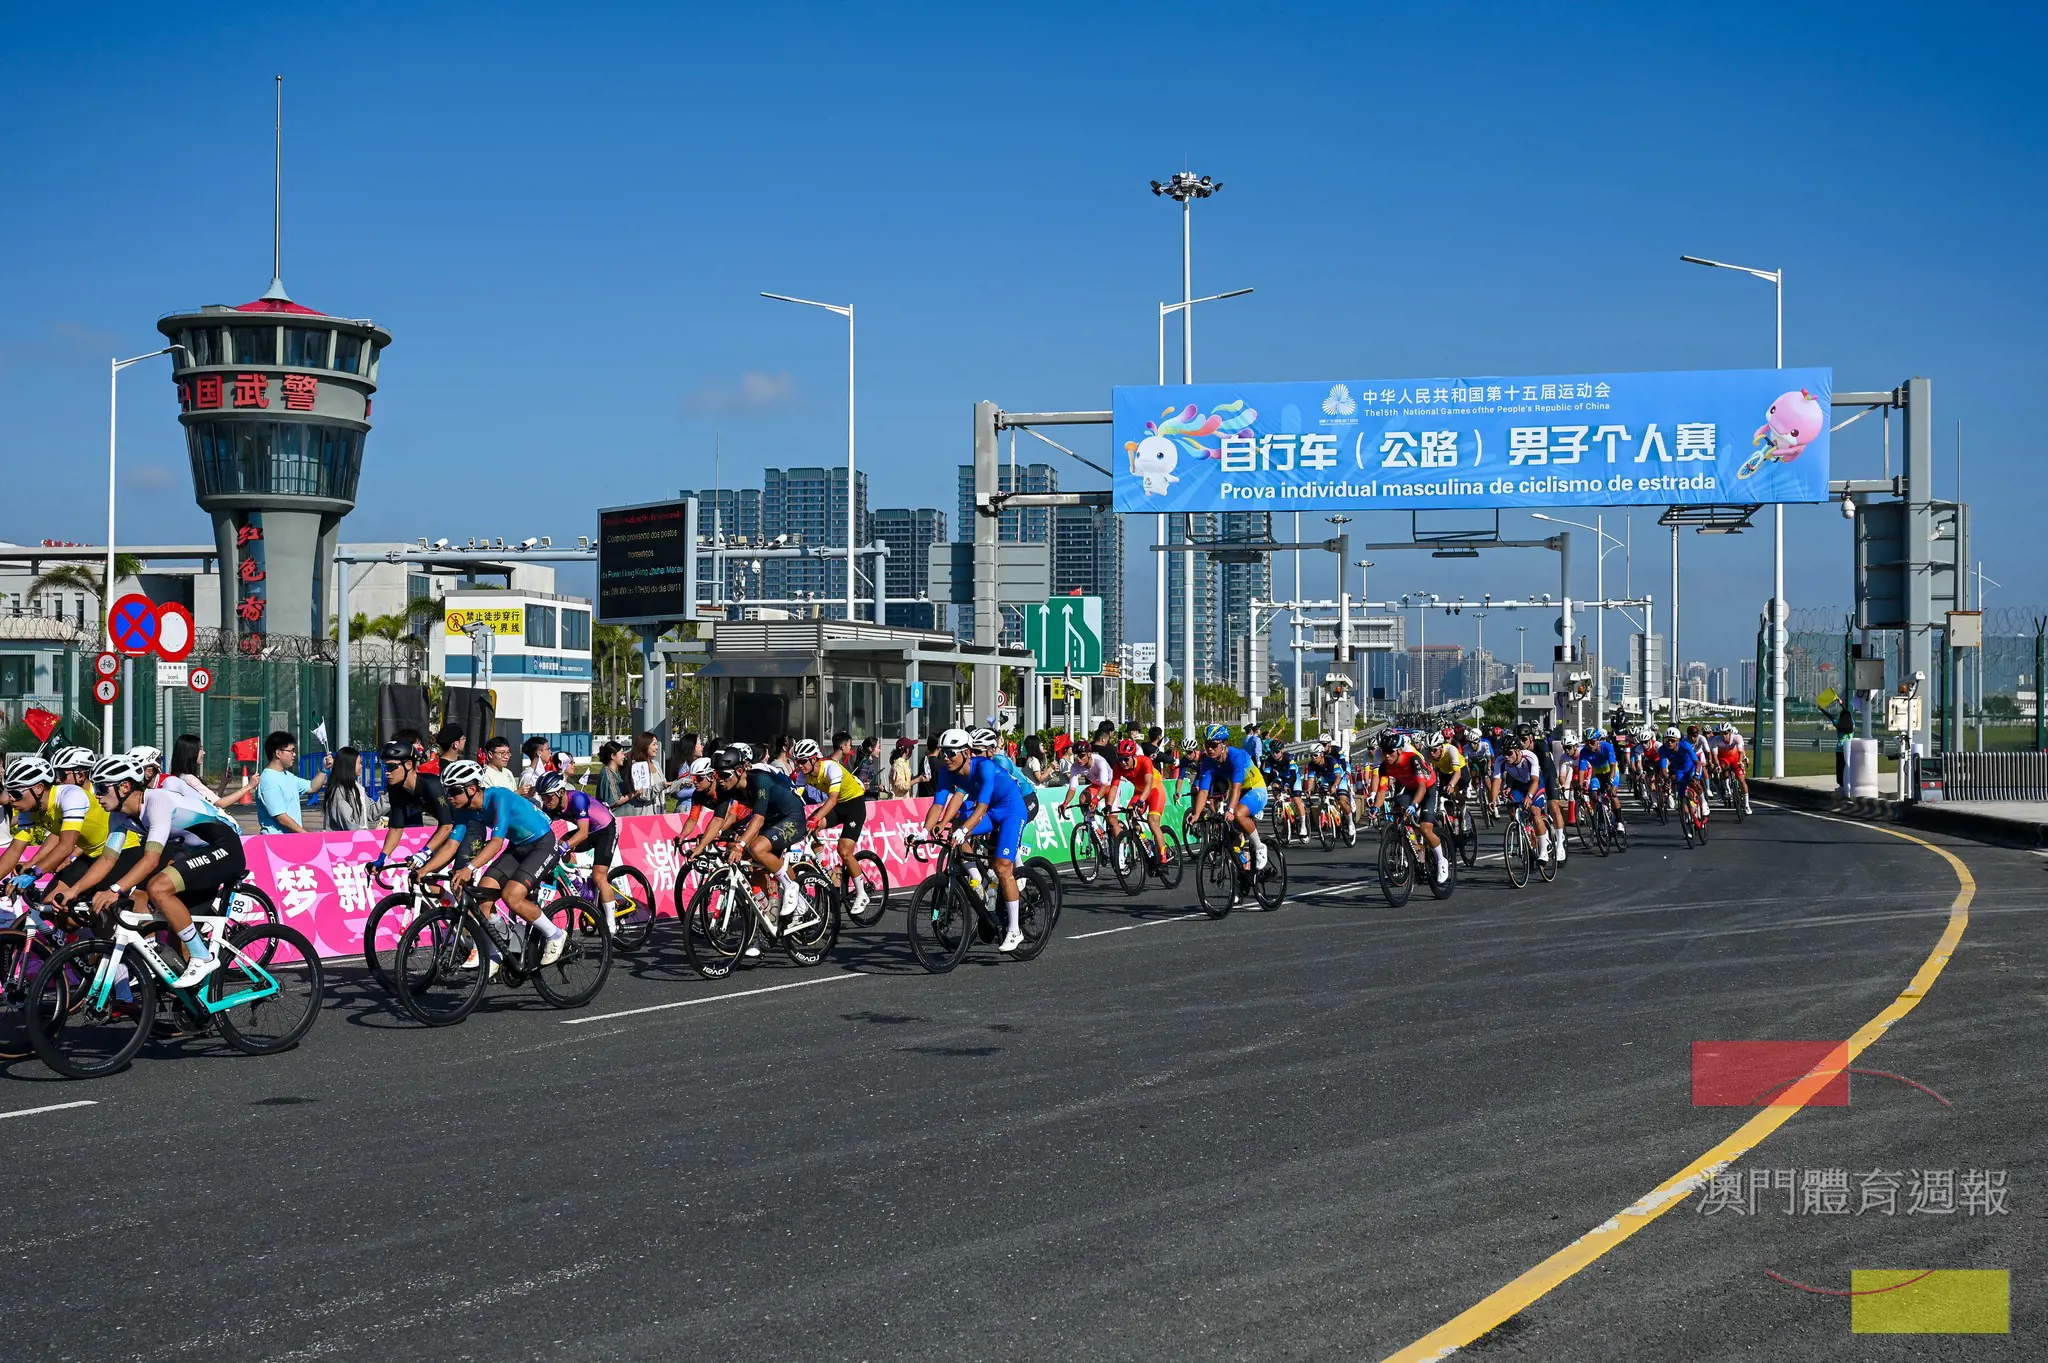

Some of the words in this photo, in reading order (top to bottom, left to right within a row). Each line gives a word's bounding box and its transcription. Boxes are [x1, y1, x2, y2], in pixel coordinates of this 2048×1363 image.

[178, 373, 319, 411] 中国武警
[1363, 382, 1611, 405] 中华人民共和国第十五届运动会
[1403, 407, 1439, 416] National
[1441, 406, 1471, 415] Games
[1497, 404, 1532, 414] People's
[1535, 403, 1572, 413] Republic
[1574, 402, 1583, 411] of
[1585, 401, 1610, 410] China
[1220, 482, 1276, 499] Prova
[1281, 480, 1378, 499] individual
[1382, 477, 1484, 498] masculina
[1489, 477, 1515, 495] de
[1518, 475, 1601, 494] ciclismo
[1607, 474, 1634, 492] de
[1638, 472, 1717, 491] estrada
[660, 529, 678, 538] postos
[466, 611, 520, 621] 禁止徒步穿行
[489, 623, 520, 633] 分界线
[194, 674, 206, 685] 40
[186, 855, 211, 869] NING
[211, 848, 229, 861] XIA
[804, 876, 829, 888] roval
[542, 888, 552, 900] 97
[232, 899, 245, 914] 88
[796, 951, 821, 963] roval
[702, 966, 730, 976] roval
